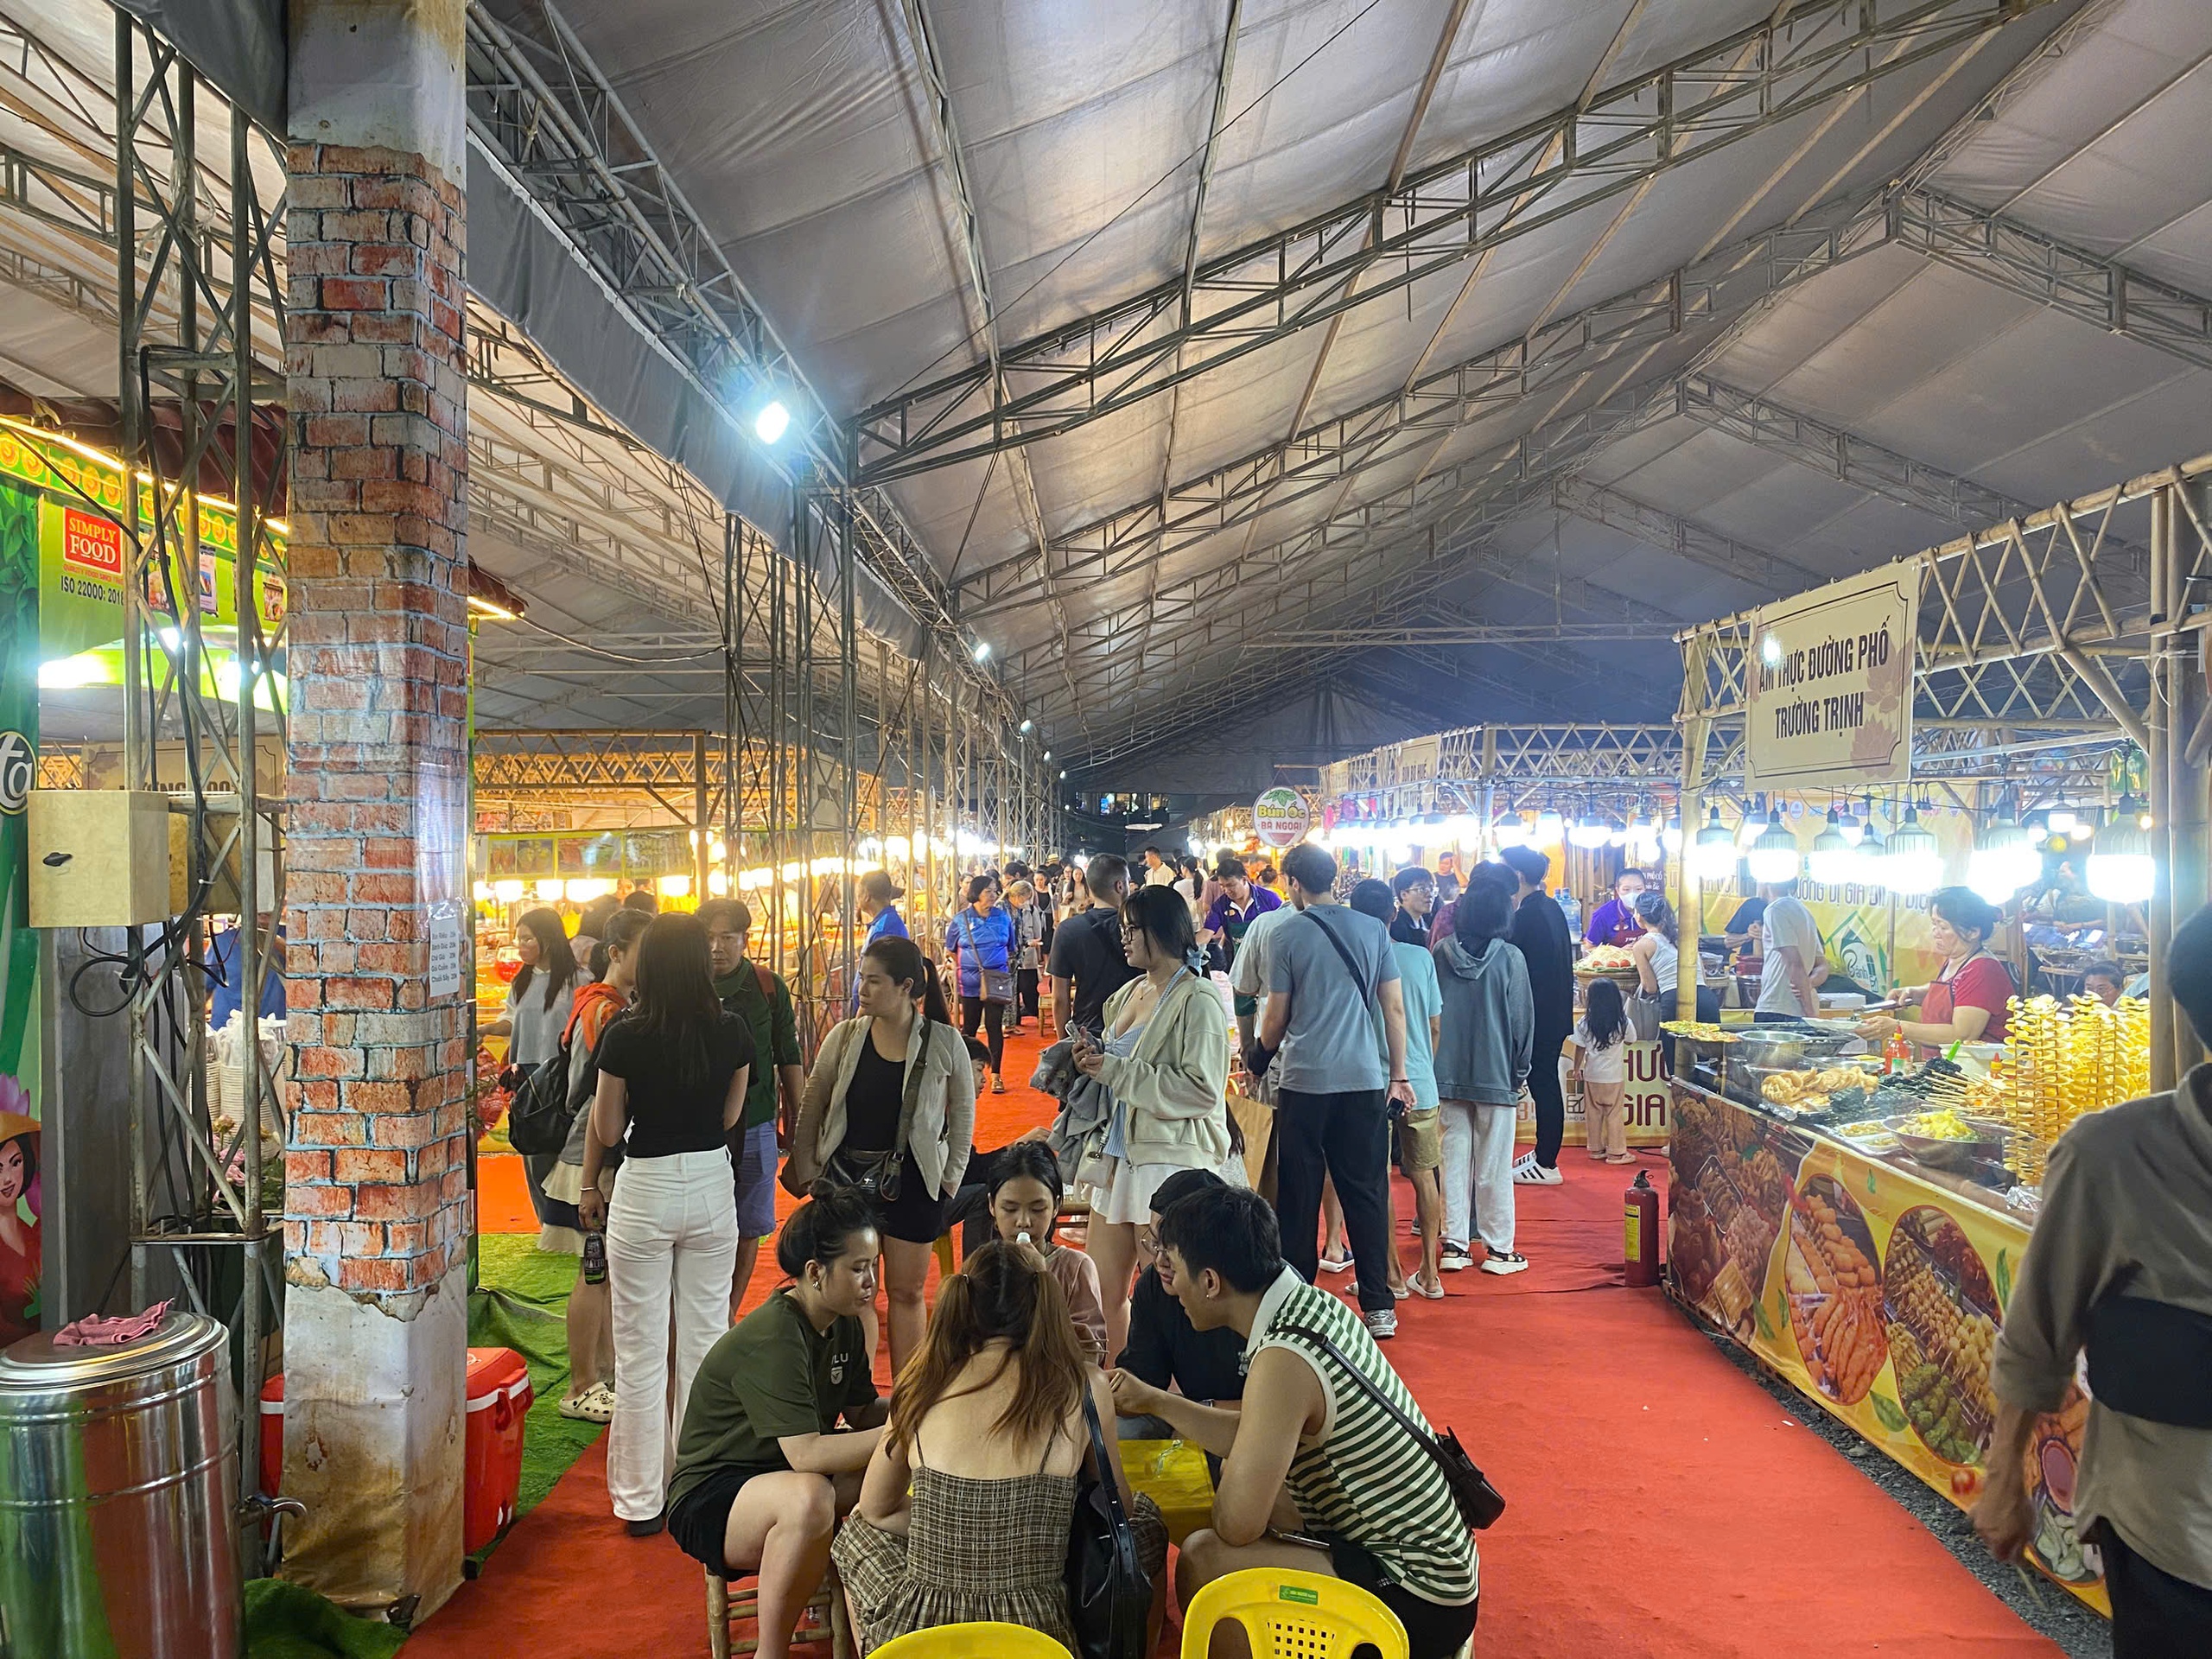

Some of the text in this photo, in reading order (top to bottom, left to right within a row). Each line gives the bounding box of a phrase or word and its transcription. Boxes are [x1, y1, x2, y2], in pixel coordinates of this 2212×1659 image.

[68, 517, 117, 544] SIMPLY
[69, 534, 117, 565] FOOD
[60, 575, 74, 594] ISO
[78, 580, 106, 601] 22000:
[1808, 634, 1853, 682] ĐƯỜNG
[1858, 614, 1891, 671] PHỐ
[1775, 691, 1864, 740] TRƯỜNG TRỊNH
[1257, 801, 1306, 819] Bún Ốc
